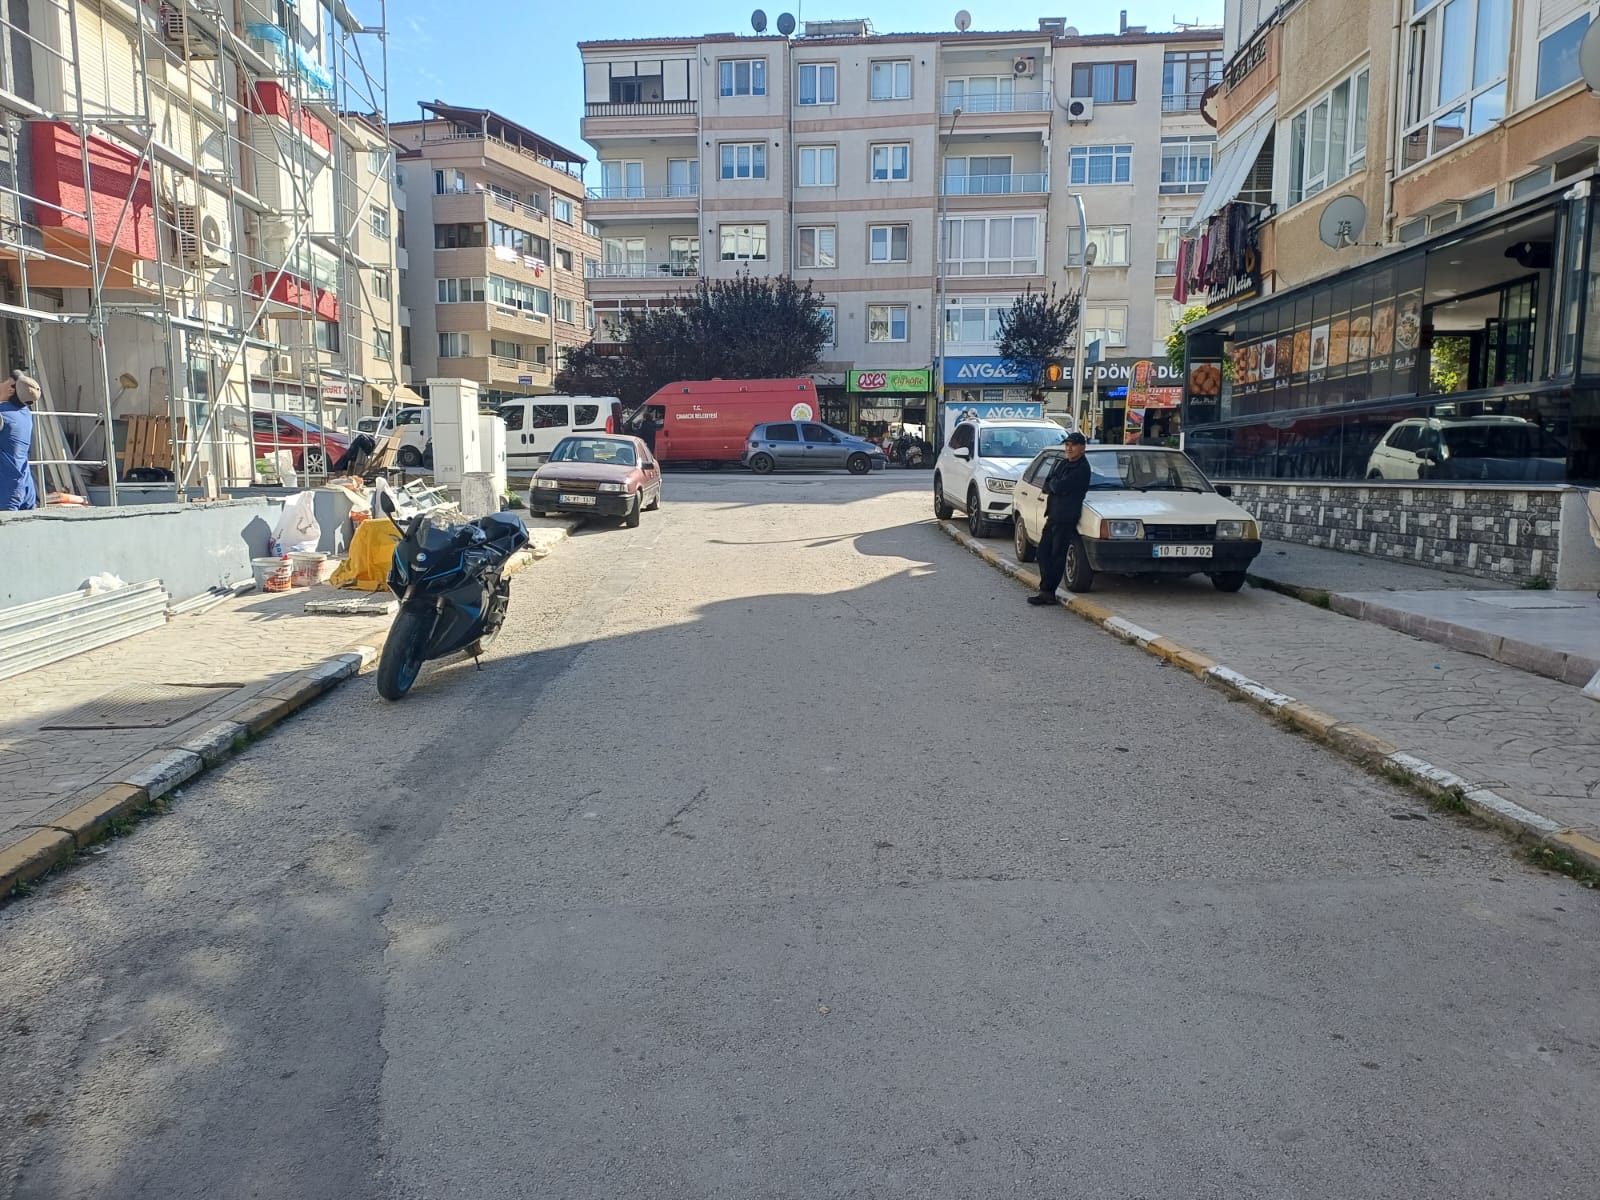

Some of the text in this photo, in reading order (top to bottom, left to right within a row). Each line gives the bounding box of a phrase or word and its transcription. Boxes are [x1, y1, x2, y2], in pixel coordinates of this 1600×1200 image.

[957, 363, 1019, 378] AYGAZ
[986, 407, 1036, 418] AYGAZ
[1159, 546, 1211, 556] 10 FU 702
